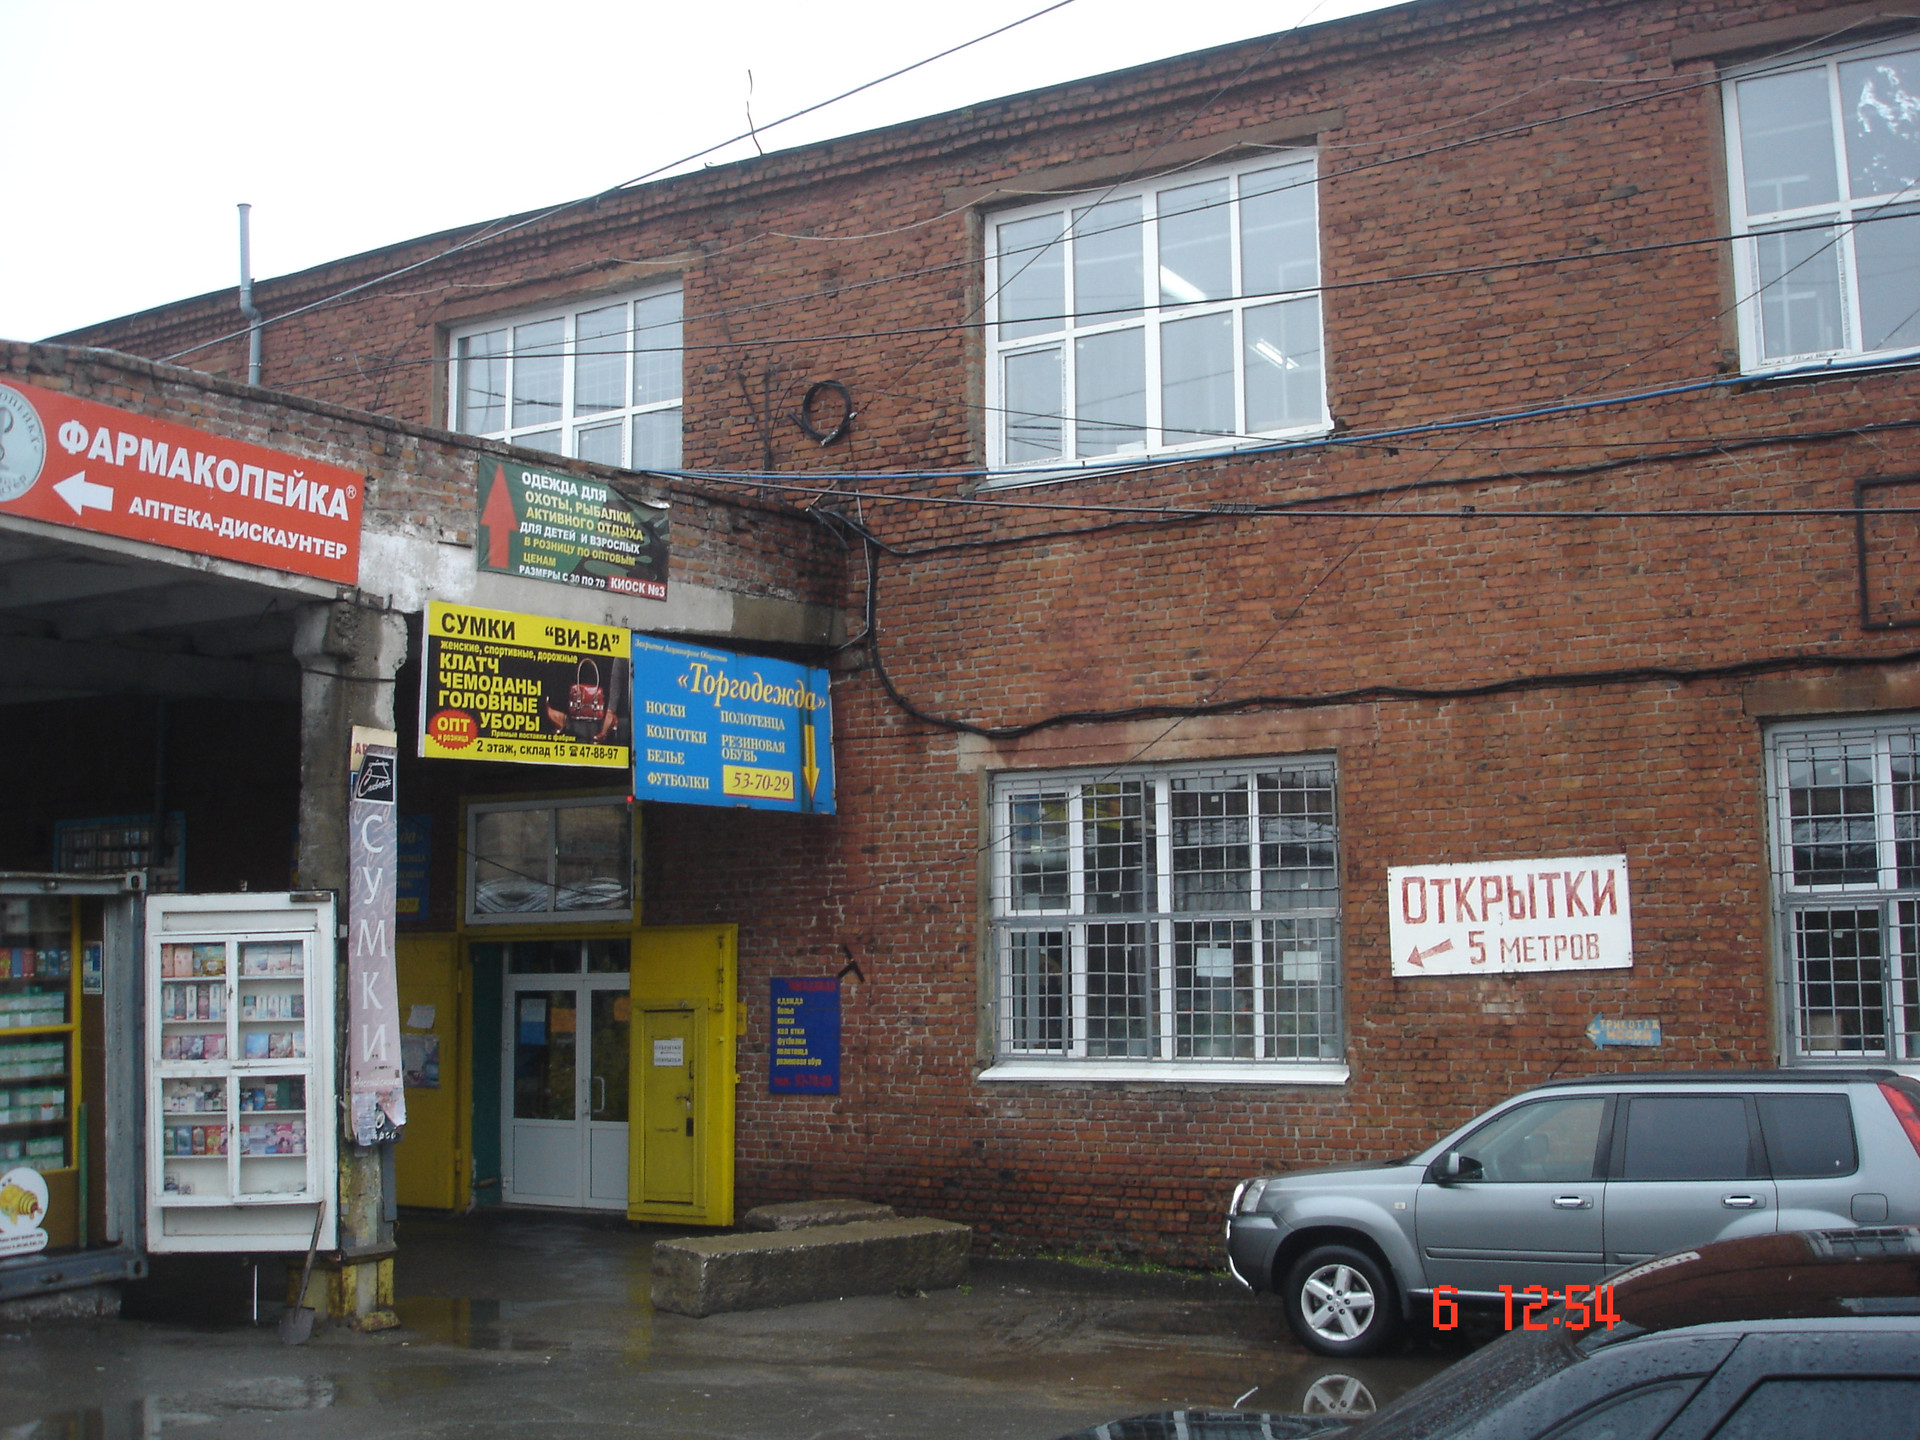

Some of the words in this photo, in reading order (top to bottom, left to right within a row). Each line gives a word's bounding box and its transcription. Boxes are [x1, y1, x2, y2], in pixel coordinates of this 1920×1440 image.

[522, 472, 578, 496] ОДЕЖДА
[581, 486, 607, 502] ДЛЯ
[525, 490, 572, 514] ОХОТЫ,
[576, 502, 635, 526] РЫБАЛКИ,
[129, 497, 348, 560] АПТЕКА-ДИСКАУНТЕР
[526, 507, 594, 530] АКТИВНОГО
[598, 522, 644, 541] ОТДЫХА
[520, 522, 542, 534] ДЛЯ
[544, 526, 576, 541] ДЕТЕЙ
[580, 534, 588, 543] И
[590, 536, 640, 554] ВЗРОСЛЫХ
[523, 552, 556, 566] ЦЕНАМ
[524, 536, 530, 546] В
[533, 538, 575, 554] РОЗНИЦУ
[577, 547, 590, 558] ПО
[592, 550, 636, 566] ОПТОВЫМ
[519, 565, 560, 580] РАЗМЕРЫ
[562, 574, 568, 582] С
[569, 574, 580, 584] 30
[582, 576, 594, 586] ПО
[595, 578, 606, 588] 70
[611, 578, 645, 593] КИОСК
[648, 584, 666, 597] №3
[442, 612, 515, 640] СУМКИ
[440, 640, 482, 655] женские,
[484, 644, 536, 661] спортивные,
[537, 652, 578, 664] дорожные
[440, 652, 499, 674] КЛАТЧ
[440, 672, 542, 696] ЧЕМОДАНЫ
[678, 662, 826, 710] «Торгодежда»
[438, 690, 538, 713] ГОЛОВНЫЕ
[646, 701, 686, 718] НОСКИ
[437, 717, 470, 732] ОПТ
[480, 712, 540, 731] УБОРЫ
[720, 710, 785, 730] ПОЛОТЕНЦА
[646, 724, 707, 744] КОЛГОТКИ
[722, 735, 785, 754] РЕЗИНОВАЯ
[477, 740, 484, 752] 2
[487, 743, 516, 756] этаж,
[520, 744, 550, 757] склад
[554, 745, 565, 756] 15
[580, 746, 618, 760] 47-88-97
[647, 749, 684, 765] БЕЛЬЕ
[722, 748, 758, 762] ОБУВЬ
[648, 772, 710, 790] ФУТБОЛКИ
[734, 772, 790, 792] 53-70-29
[1402, 870, 1618, 924] ОТКРЫТКИ
[1468, 930, 1486, 964] 5
[1500, 933, 1600, 963] МЕТРОВ
